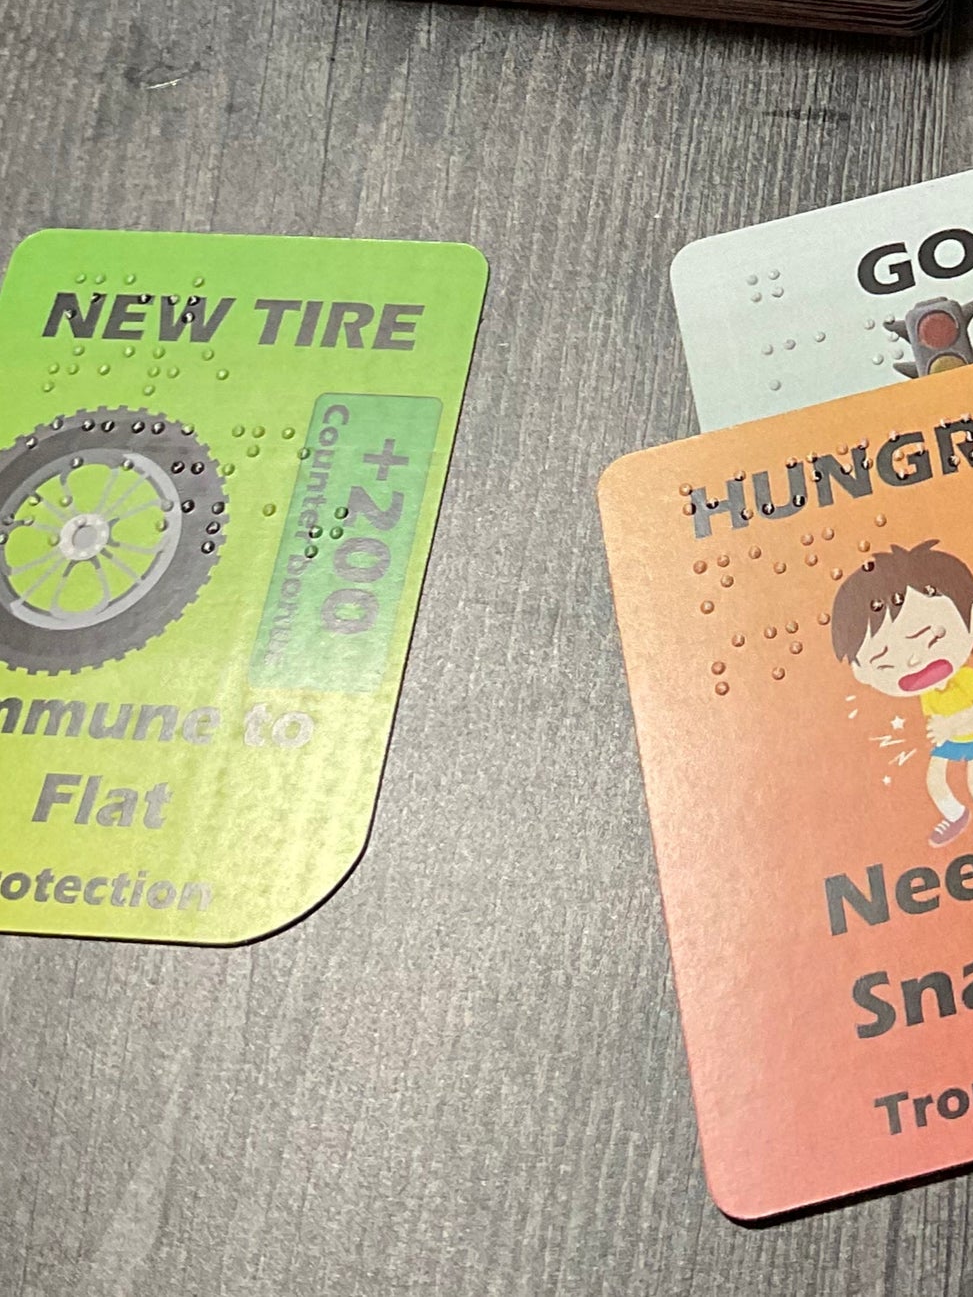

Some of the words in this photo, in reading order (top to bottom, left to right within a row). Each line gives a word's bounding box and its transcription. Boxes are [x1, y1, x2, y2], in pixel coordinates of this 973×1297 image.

[42, 292, 237, 346] NEW
[254, 298, 426, 351] TIRE
[295, 404, 349, 543] Counter
[319, 437, 410, 635] +200
[243, 703, 314, 747] to
[31, 773, 173, 829] Flat
[0, 868, 213, 912] otection
